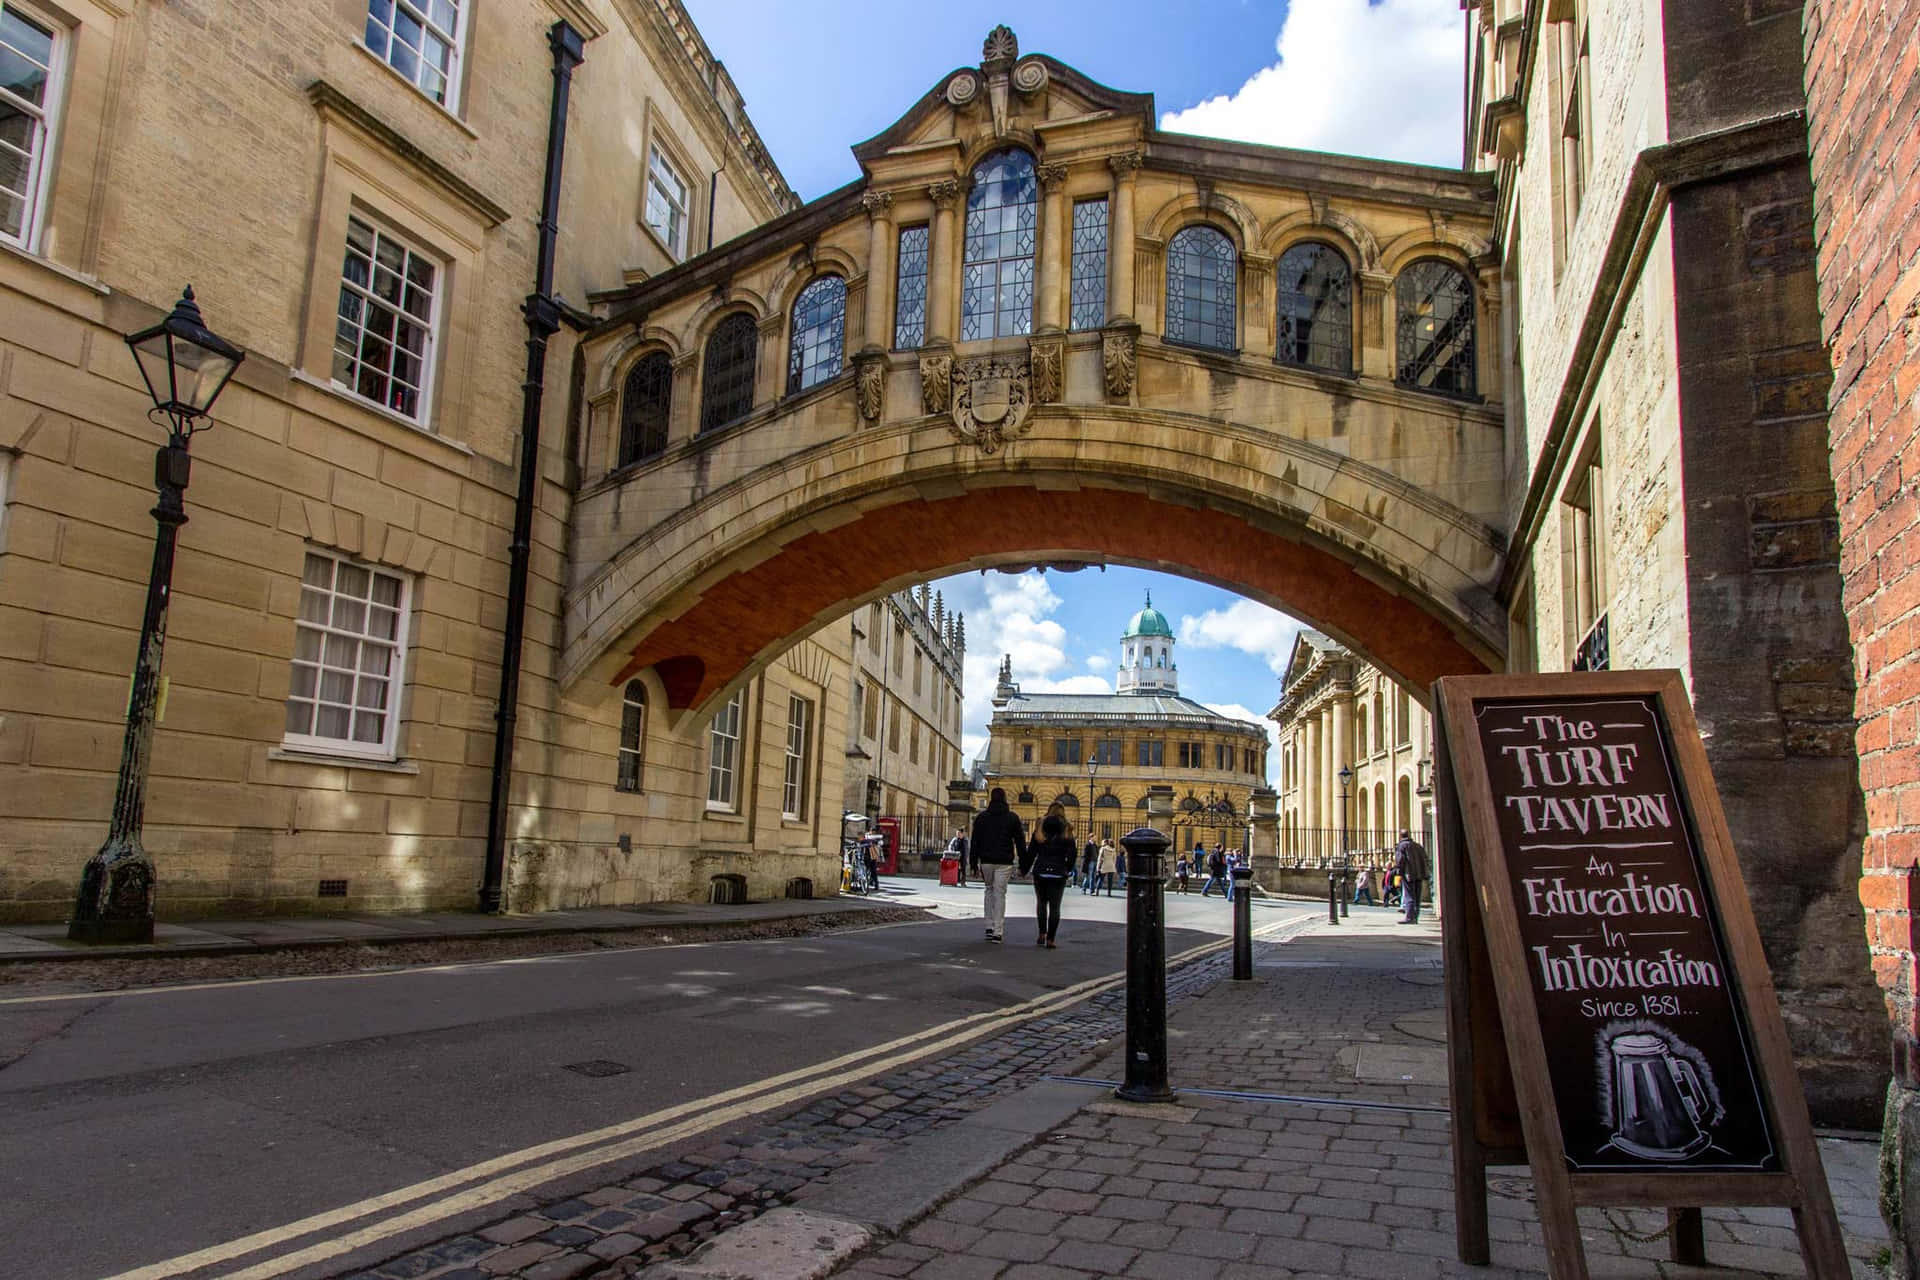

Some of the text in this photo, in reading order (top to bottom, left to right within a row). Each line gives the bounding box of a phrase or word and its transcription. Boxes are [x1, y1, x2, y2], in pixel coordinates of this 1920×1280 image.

[1522, 714, 1596, 742] The
[1501, 744, 1640, 789] TURF
[1504, 793, 1674, 835] TAVERN
[1585, 854, 1614, 877] An
[1522, 874, 1700, 919] Education
[1602, 920, 1627, 948] In
[1532, 943, 1721, 993] Intoxication
[1580, 997, 1637, 1019] Since
